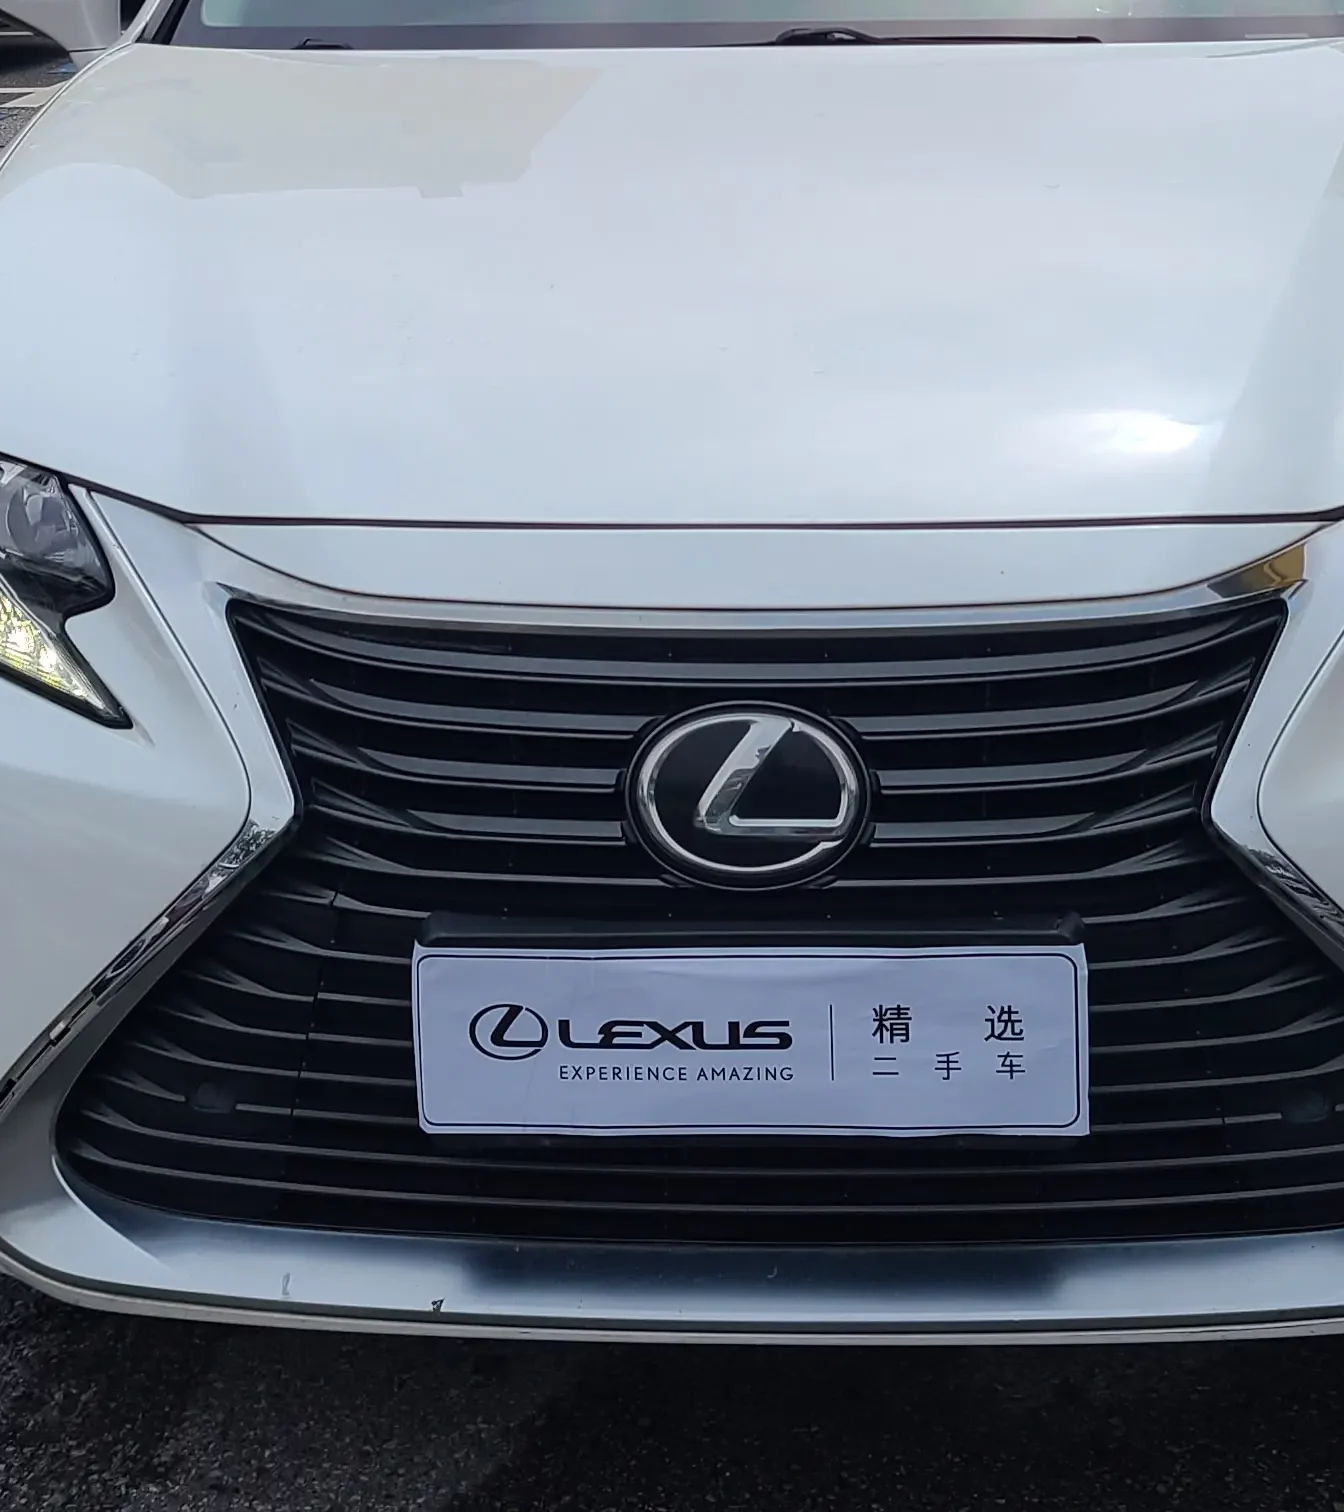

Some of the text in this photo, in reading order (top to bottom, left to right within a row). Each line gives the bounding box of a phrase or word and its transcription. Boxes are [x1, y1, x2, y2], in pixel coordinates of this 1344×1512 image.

[559, 1018, 793, 1051] LEXUS
[559, 1064, 795, 1082] EXPERIENCE AMAZING
